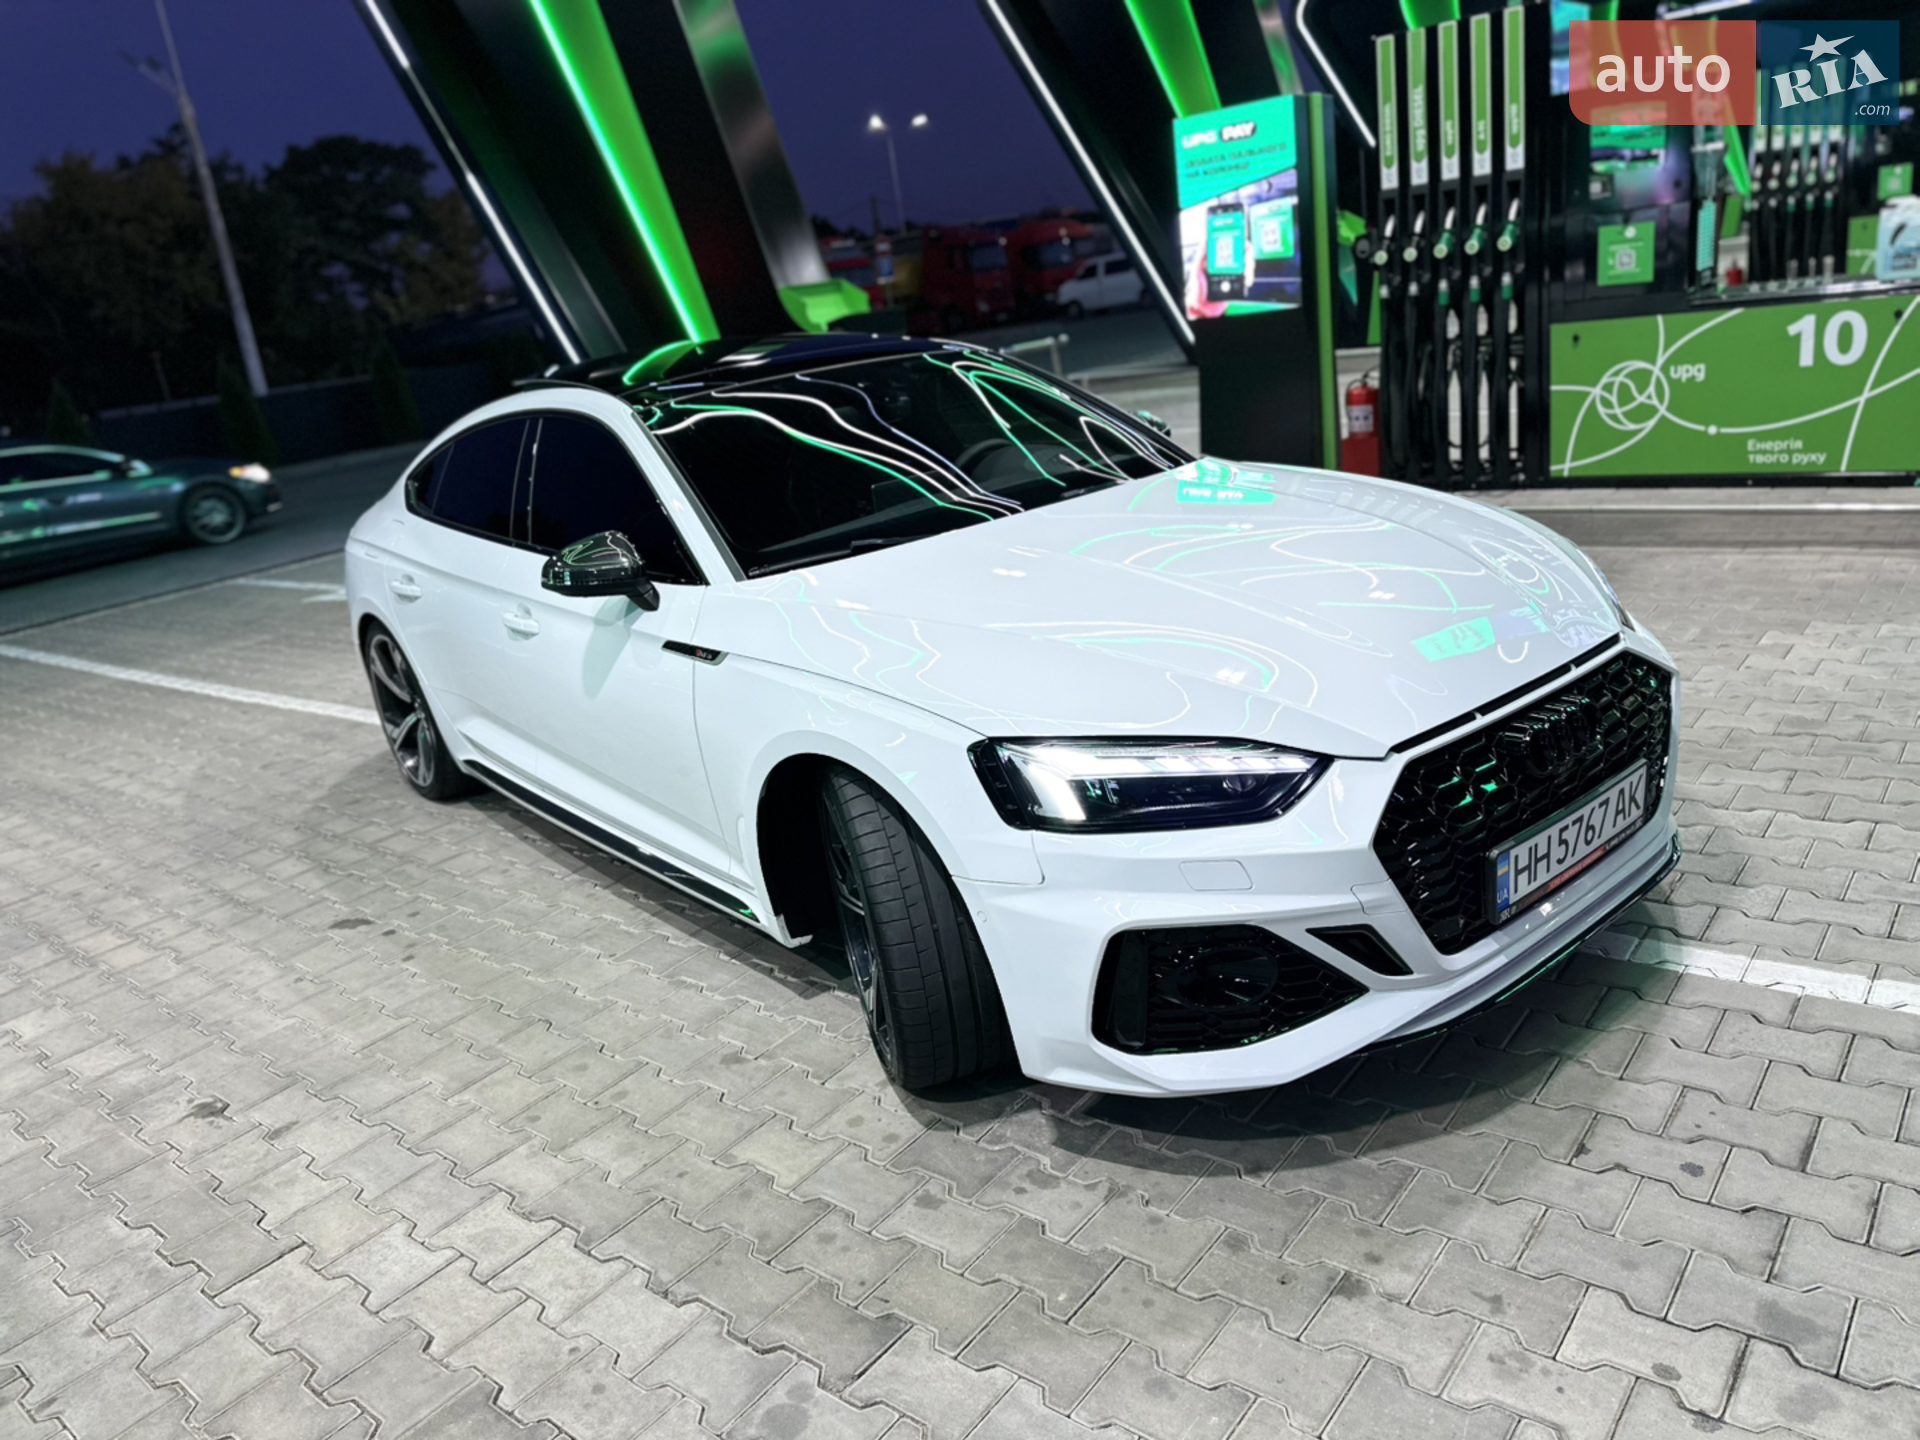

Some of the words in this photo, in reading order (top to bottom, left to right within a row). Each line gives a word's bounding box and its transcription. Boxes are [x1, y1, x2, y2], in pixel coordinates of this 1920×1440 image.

[1412, 84, 1425, 127] DIESEL
[1786, 310, 1868, 367] 10
[1670, 363, 1706, 383] upg
[1747, 438, 1803, 453] Енергія
[1748, 453, 1789, 464] твого
[1792, 452, 1827, 466] руху
[1514, 834, 1552, 894] HH
[1556, 797, 1610, 866] 5767
[1612, 773, 1644, 829] AK
